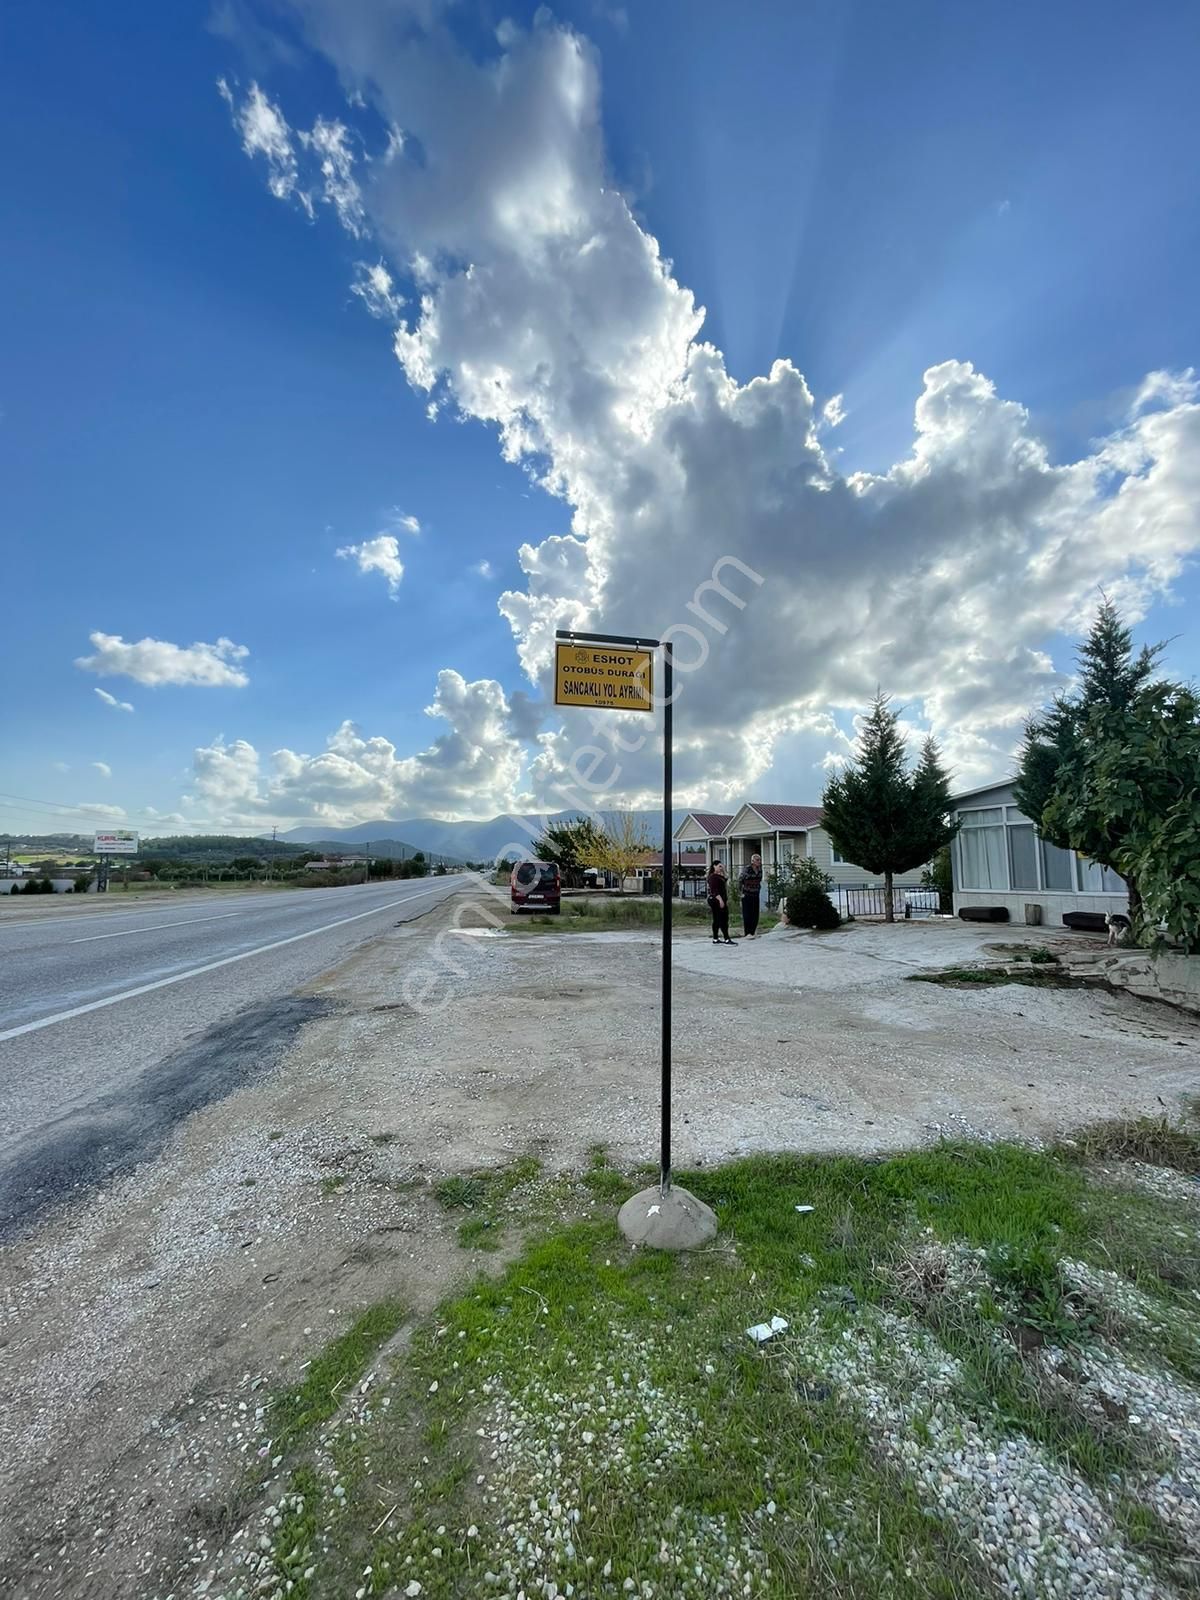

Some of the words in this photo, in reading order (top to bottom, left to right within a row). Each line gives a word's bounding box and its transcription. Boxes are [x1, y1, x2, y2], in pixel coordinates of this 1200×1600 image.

[593, 655, 633, 665] ESHOT
[563, 680, 601, 697] SANCAKLI
[603, 684, 617, 698] YOL
